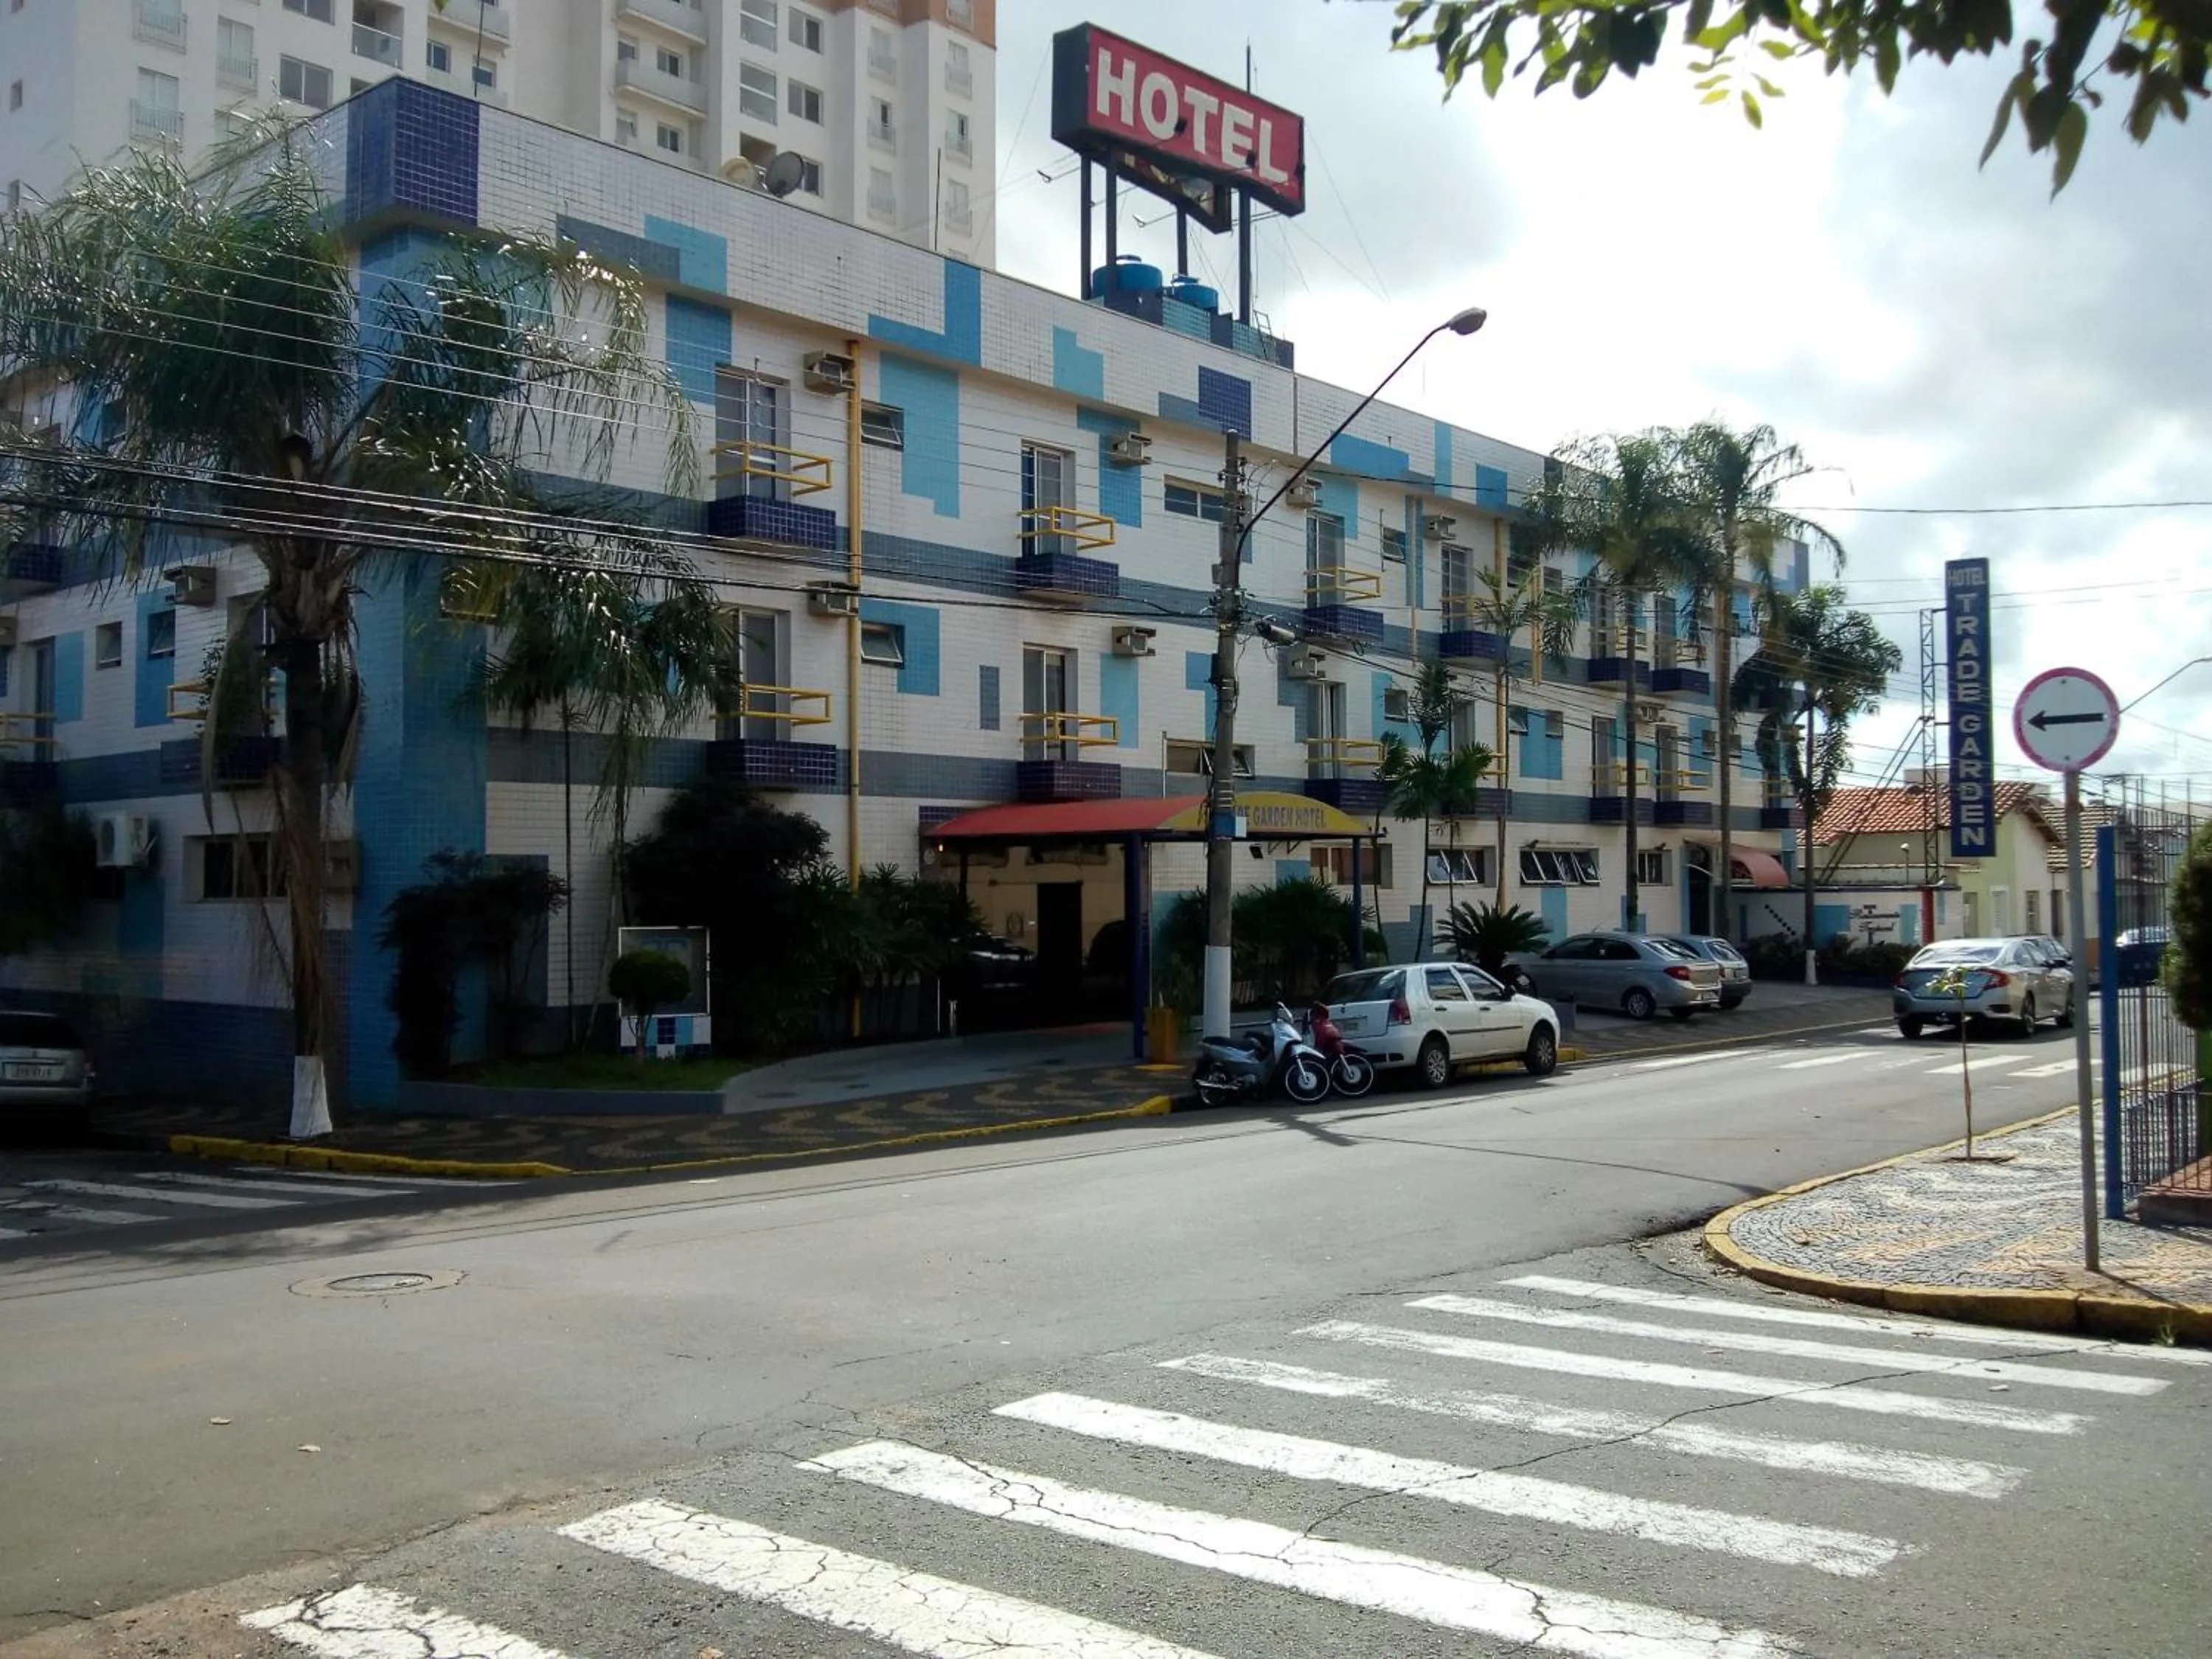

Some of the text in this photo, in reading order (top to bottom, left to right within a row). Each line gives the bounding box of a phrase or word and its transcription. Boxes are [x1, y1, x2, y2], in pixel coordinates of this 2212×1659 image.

[1096, 47, 1289, 185] HOTEL
[1947, 567, 1986, 588] HOTEL
[1955, 593, 1985, 846] TRADE GARDEN
[1253, 805, 1293, 827] GARDEN
[1295, 807, 1327, 829] HOTEL
